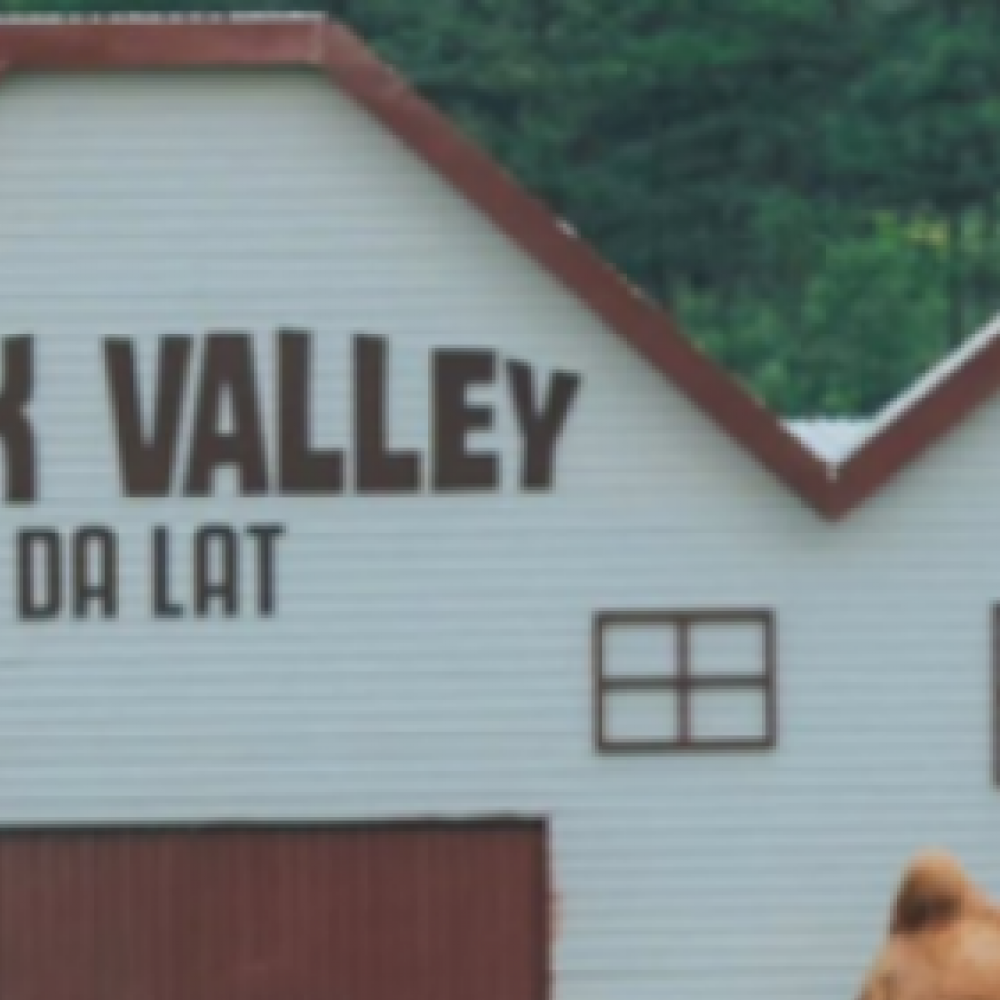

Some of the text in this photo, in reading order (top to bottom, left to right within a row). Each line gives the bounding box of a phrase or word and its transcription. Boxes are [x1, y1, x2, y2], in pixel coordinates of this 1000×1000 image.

[104, 329, 583, 498] VALLEY
[17, 524, 285, 621] DA LAT
